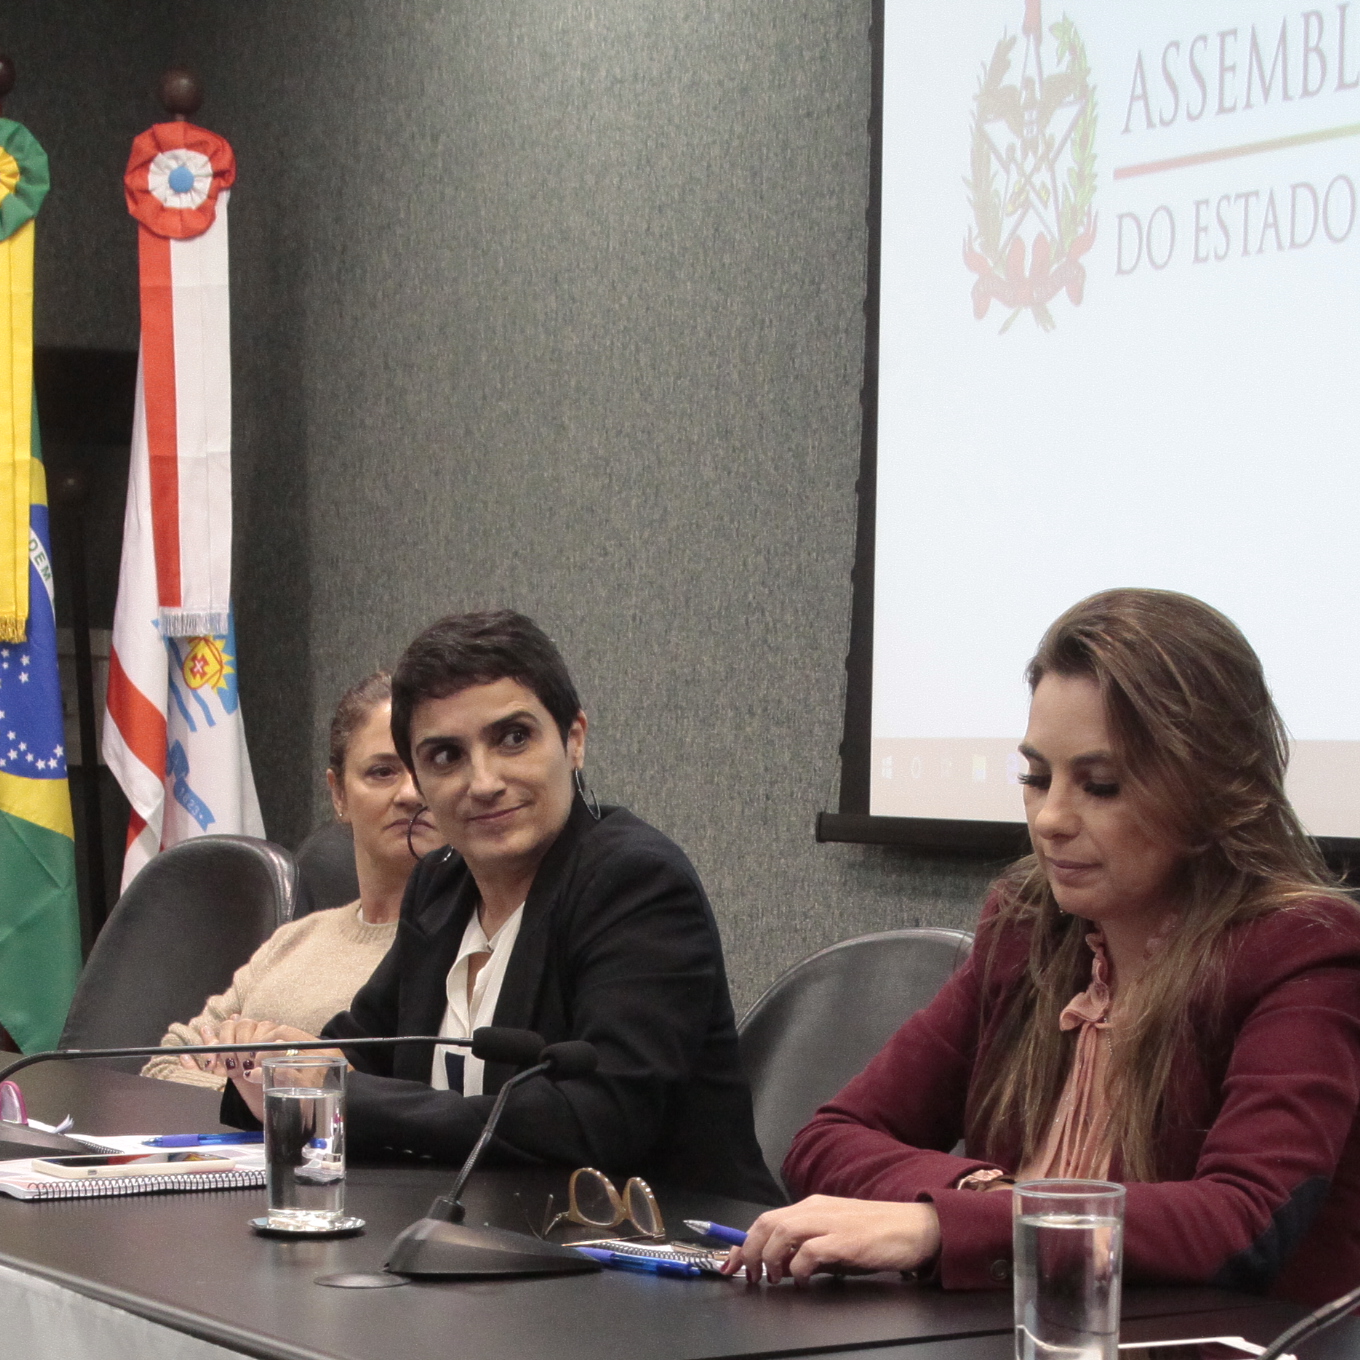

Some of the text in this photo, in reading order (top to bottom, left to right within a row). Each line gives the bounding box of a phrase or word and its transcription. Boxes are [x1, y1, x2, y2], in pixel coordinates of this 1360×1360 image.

[1114, 204, 1177, 277] DO
[1191, 173, 1358, 265] ESTADO
[29, 539, 51, 581] DEM
